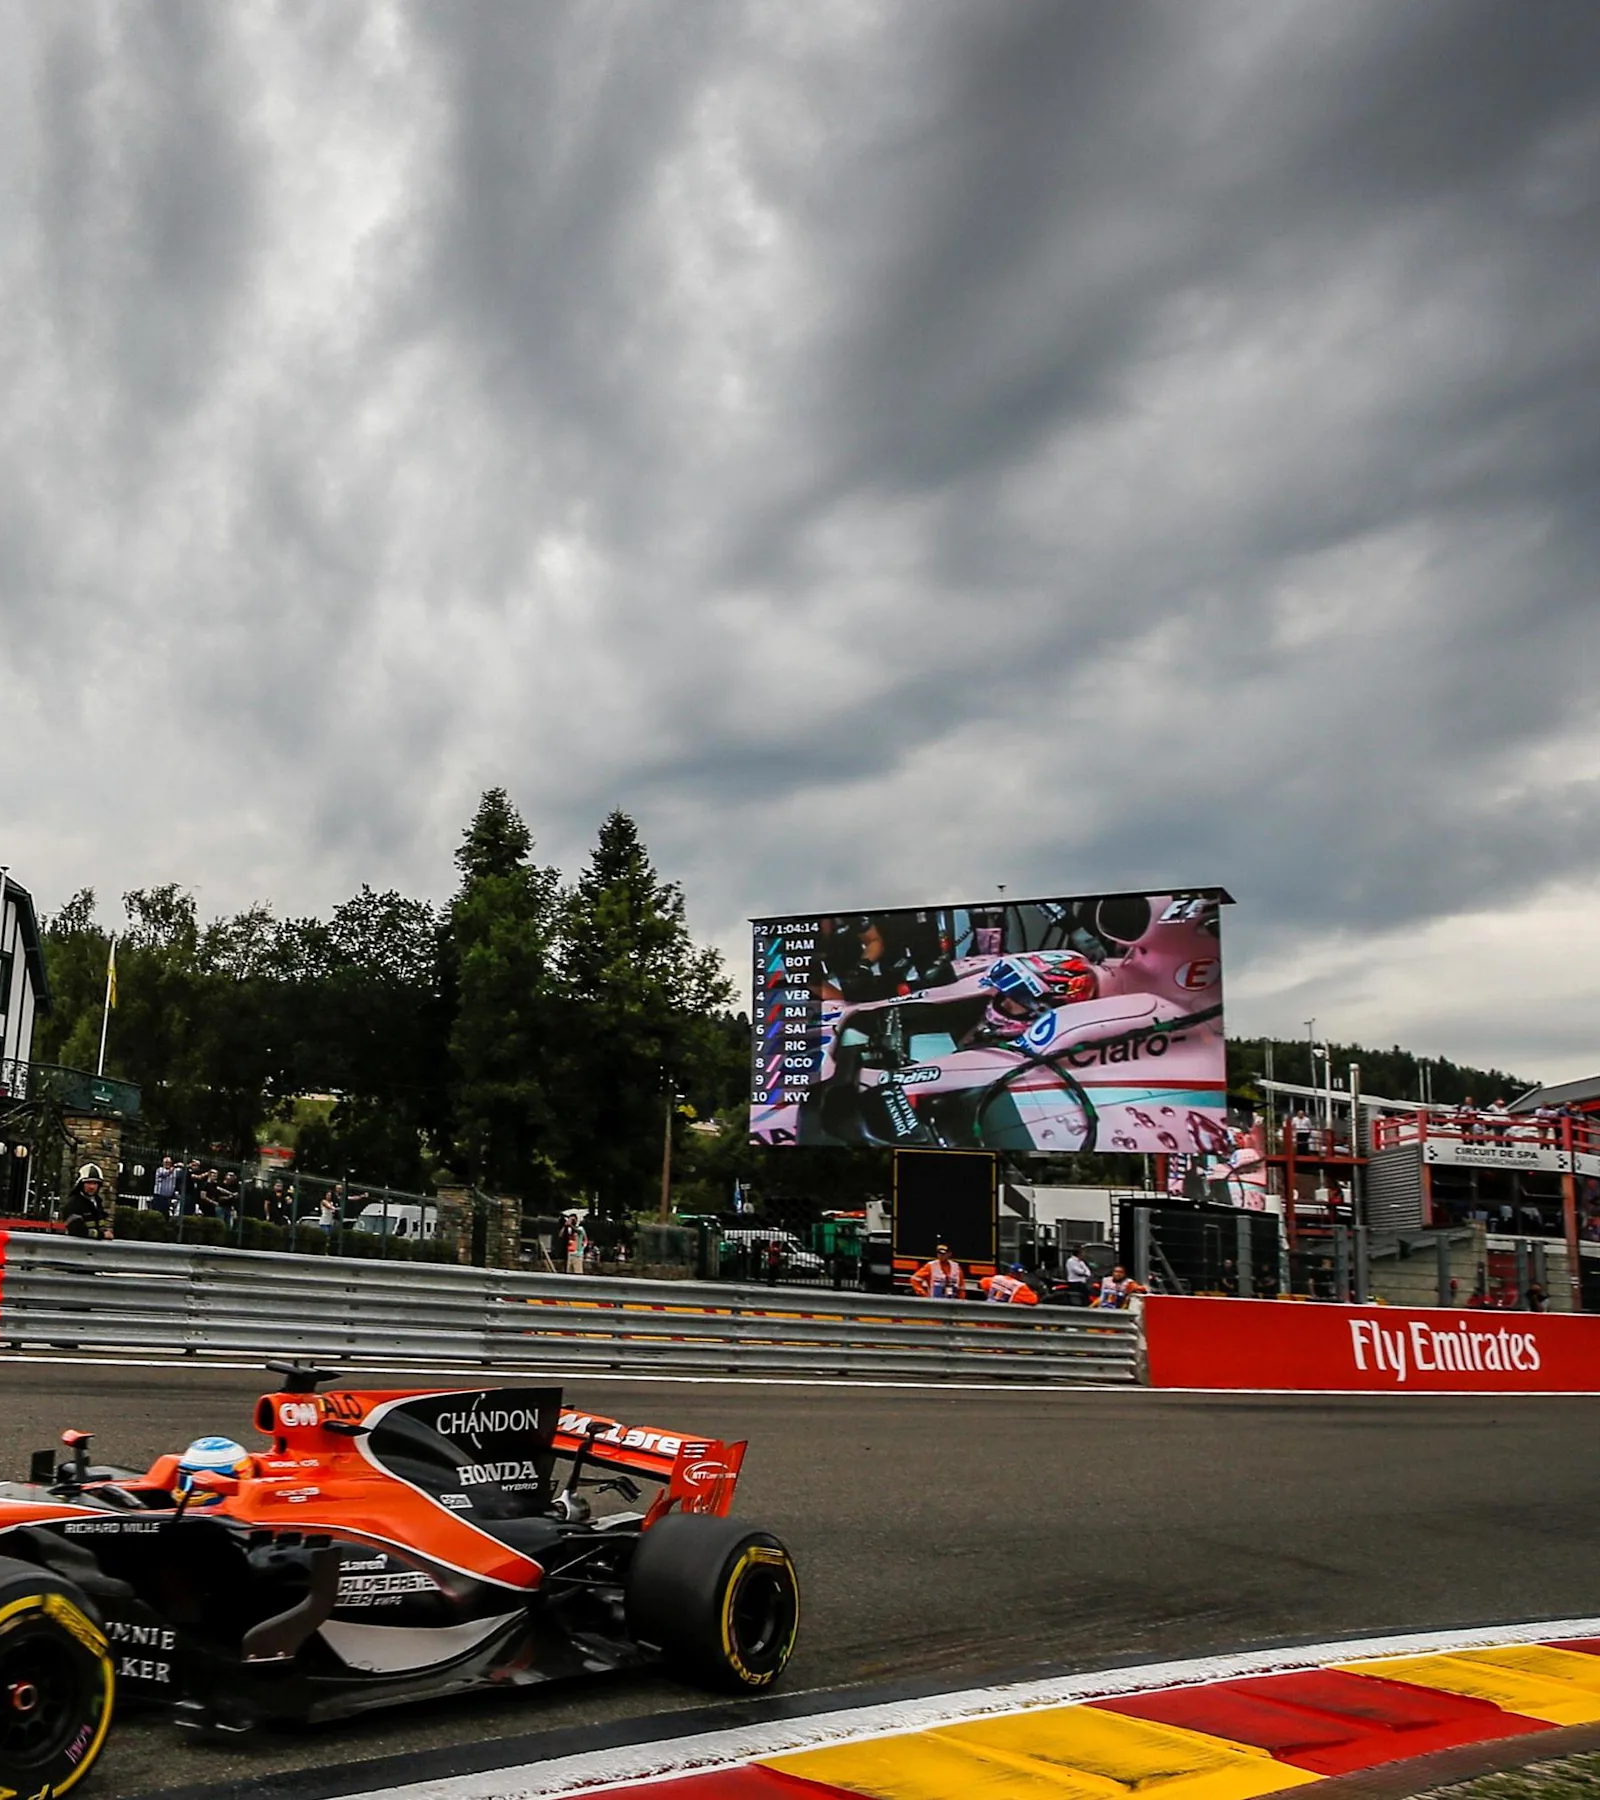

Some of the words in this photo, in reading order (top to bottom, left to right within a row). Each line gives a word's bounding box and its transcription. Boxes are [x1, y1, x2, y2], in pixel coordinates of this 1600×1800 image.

[757, 942, 765, 952] 1
[785, 940, 815, 950] HAM
[756, 959, 766, 969] 2
[785, 956, 812, 967] BOT
[756, 975, 766, 985] 3
[784, 973, 810, 984] VET
[755, 992, 765, 1001] 4
[784, 990, 810, 1000] VER
[756, 1008, 765, 1018] 5
[784, 1007, 806, 1017] RAI
[756, 1025, 765, 1035] 6
[784, 1024, 806, 1034] SAI
[756, 1041, 765, 1051] 7
[784, 1041, 807, 1051] RIC
[755, 1058, 765, 1068] 8
[784, 1058, 813, 1068] OCO
[755, 1075, 764, 1085] 9
[784, 1075, 809, 1085] PER
[752, 1092, 767, 1102] 10
[784, 1092, 810, 1102] KVY
[1455, 1147, 1496, 1156] CIRCUIT
[1500, 1150, 1514, 1158] DE
[1349, 1320, 1407, 1382] Fly
[1408, 1320, 1541, 1371] Emirates
[436, 1409, 539, 1434] CHANDON
[456, 1461, 539, 1486] HONDA
[65, 1523, 120, 1533] RICHARD
[122, 1523, 160, 1533] MILLE
